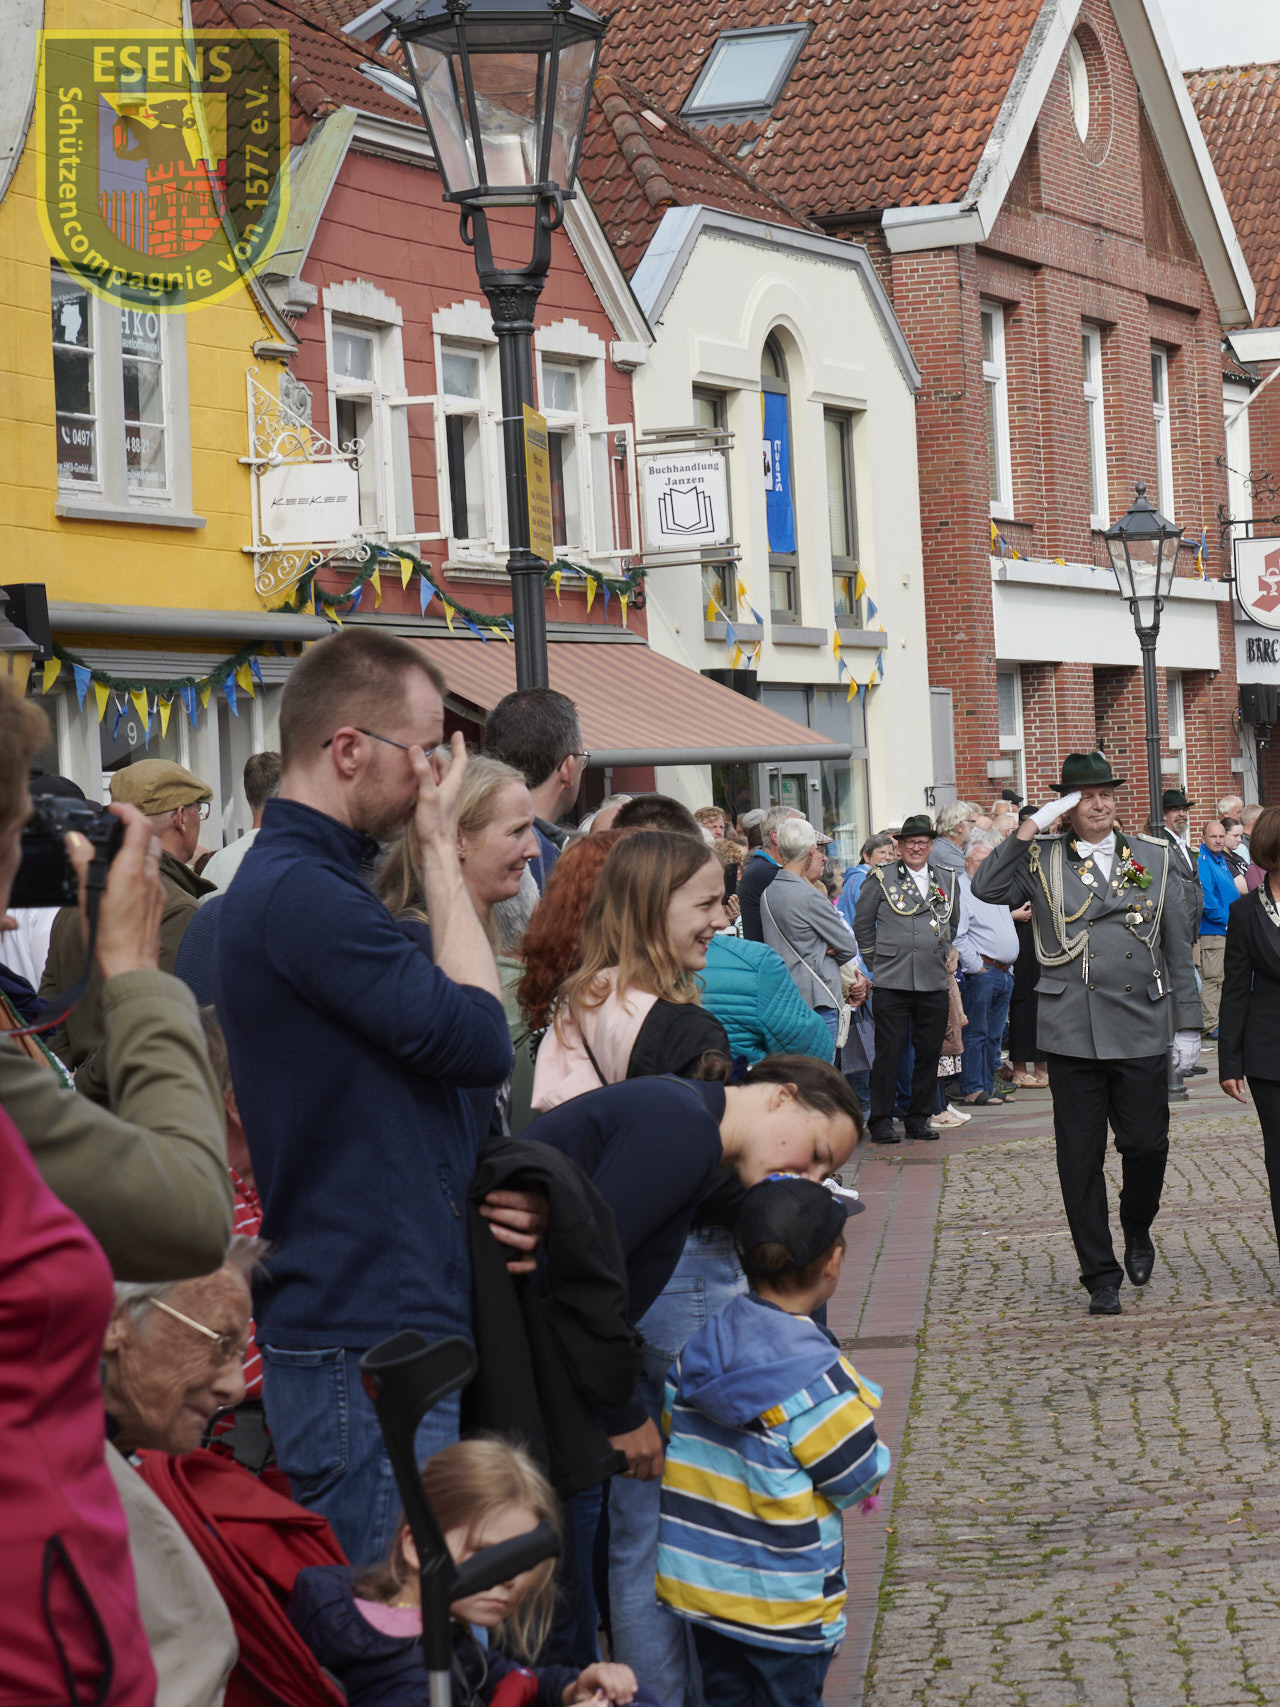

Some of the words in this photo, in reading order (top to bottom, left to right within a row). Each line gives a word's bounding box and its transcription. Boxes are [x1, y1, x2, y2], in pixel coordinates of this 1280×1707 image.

[648, 462, 720, 475] Buchhandlung
[664, 476, 705, 486] Janzen
[127, 721, 138, 746] 9
[924, 786, 936, 807] 13
